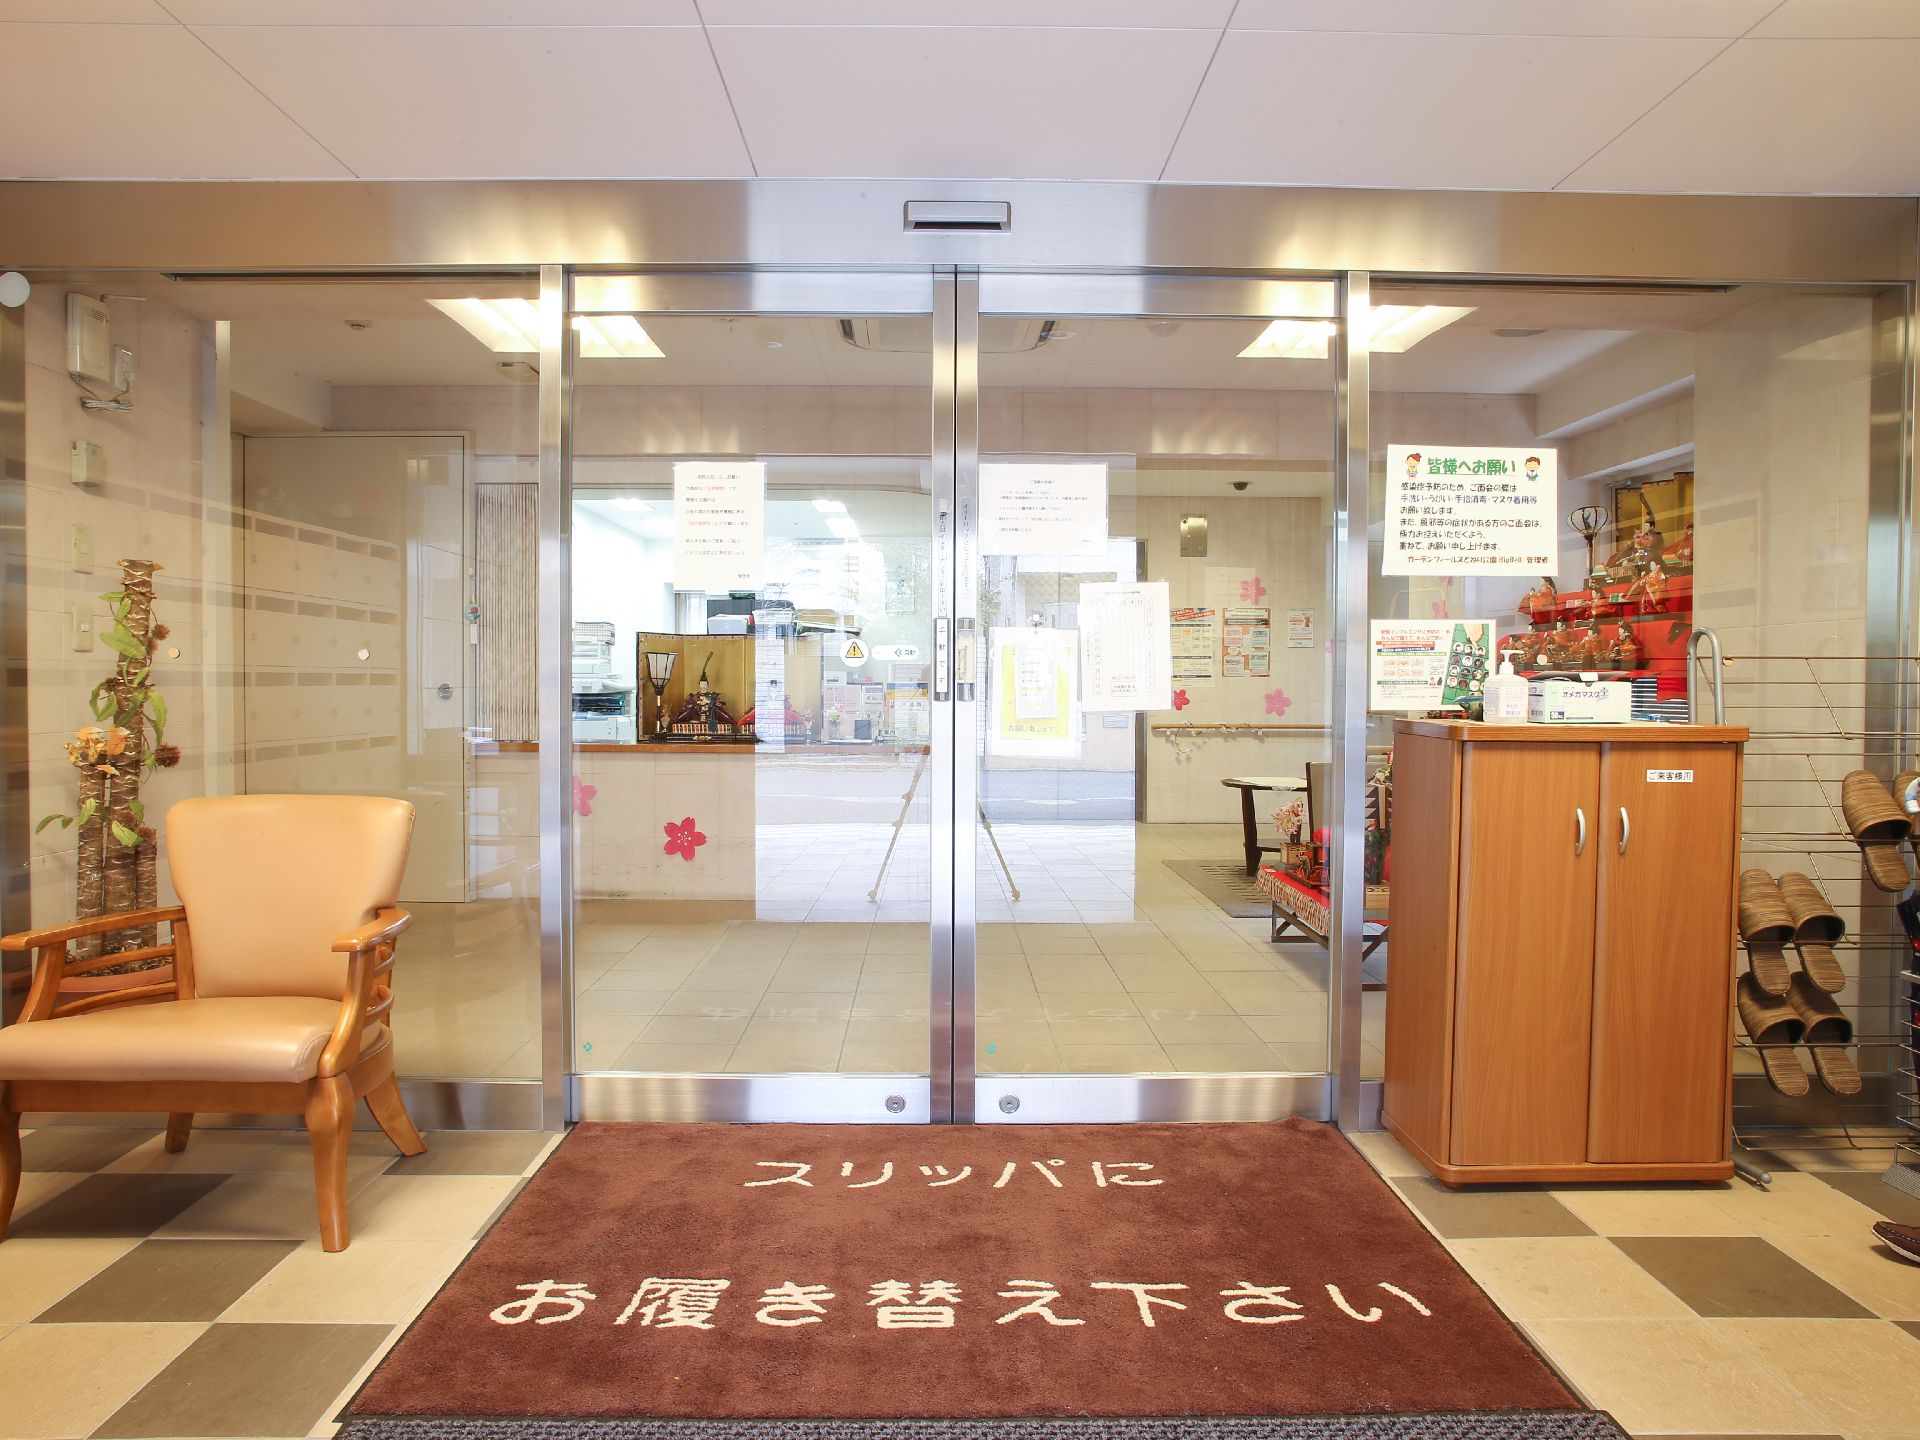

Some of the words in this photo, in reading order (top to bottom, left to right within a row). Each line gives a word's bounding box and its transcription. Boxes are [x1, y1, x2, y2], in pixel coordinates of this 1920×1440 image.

[1427, 456, 1516, 476] 皆様へお願い
[743, 1159, 1165, 1188] スリッパに
[489, 1277, 1432, 1329] お履き替え下さい
